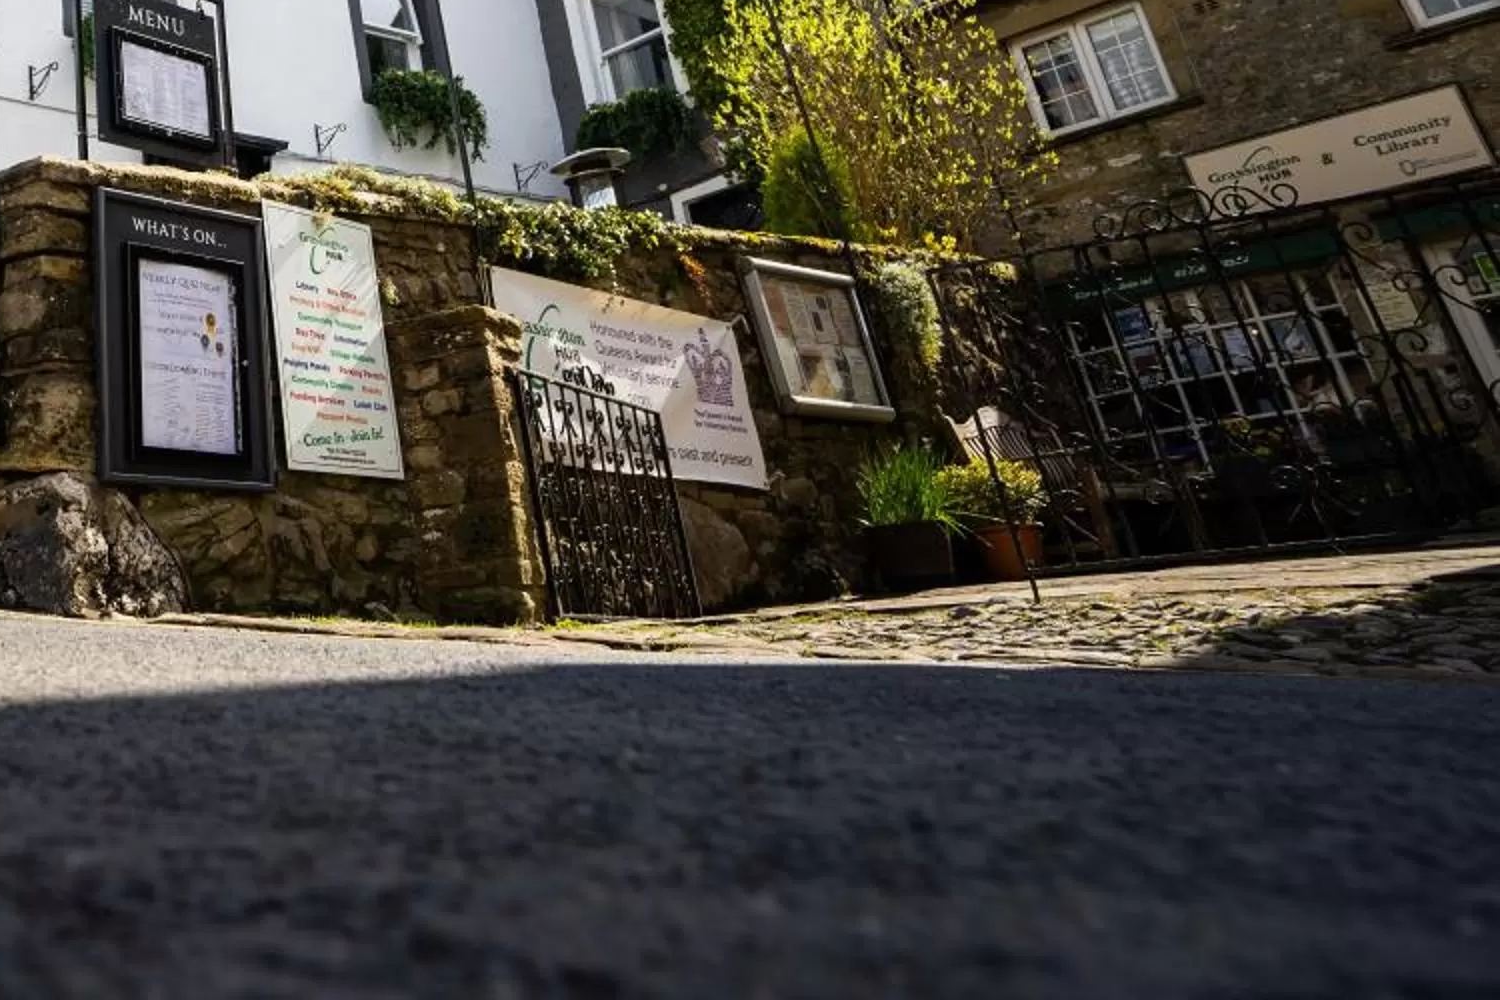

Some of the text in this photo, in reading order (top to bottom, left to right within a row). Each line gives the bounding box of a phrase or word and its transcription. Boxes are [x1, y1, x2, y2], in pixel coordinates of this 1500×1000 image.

[128, 4, 185, 37] MENU
[1353, 115, 1452, 147] Community
[1376, 132, 1441, 156] Library
[1208, 154, 1301, 184] Grassington
[1321, 152, 1335, 165] &
[1259, 169, 1292, 185] HUB
[132, 216, 190, 241] WHAT'S
[524, 322, 586, 347] assington
